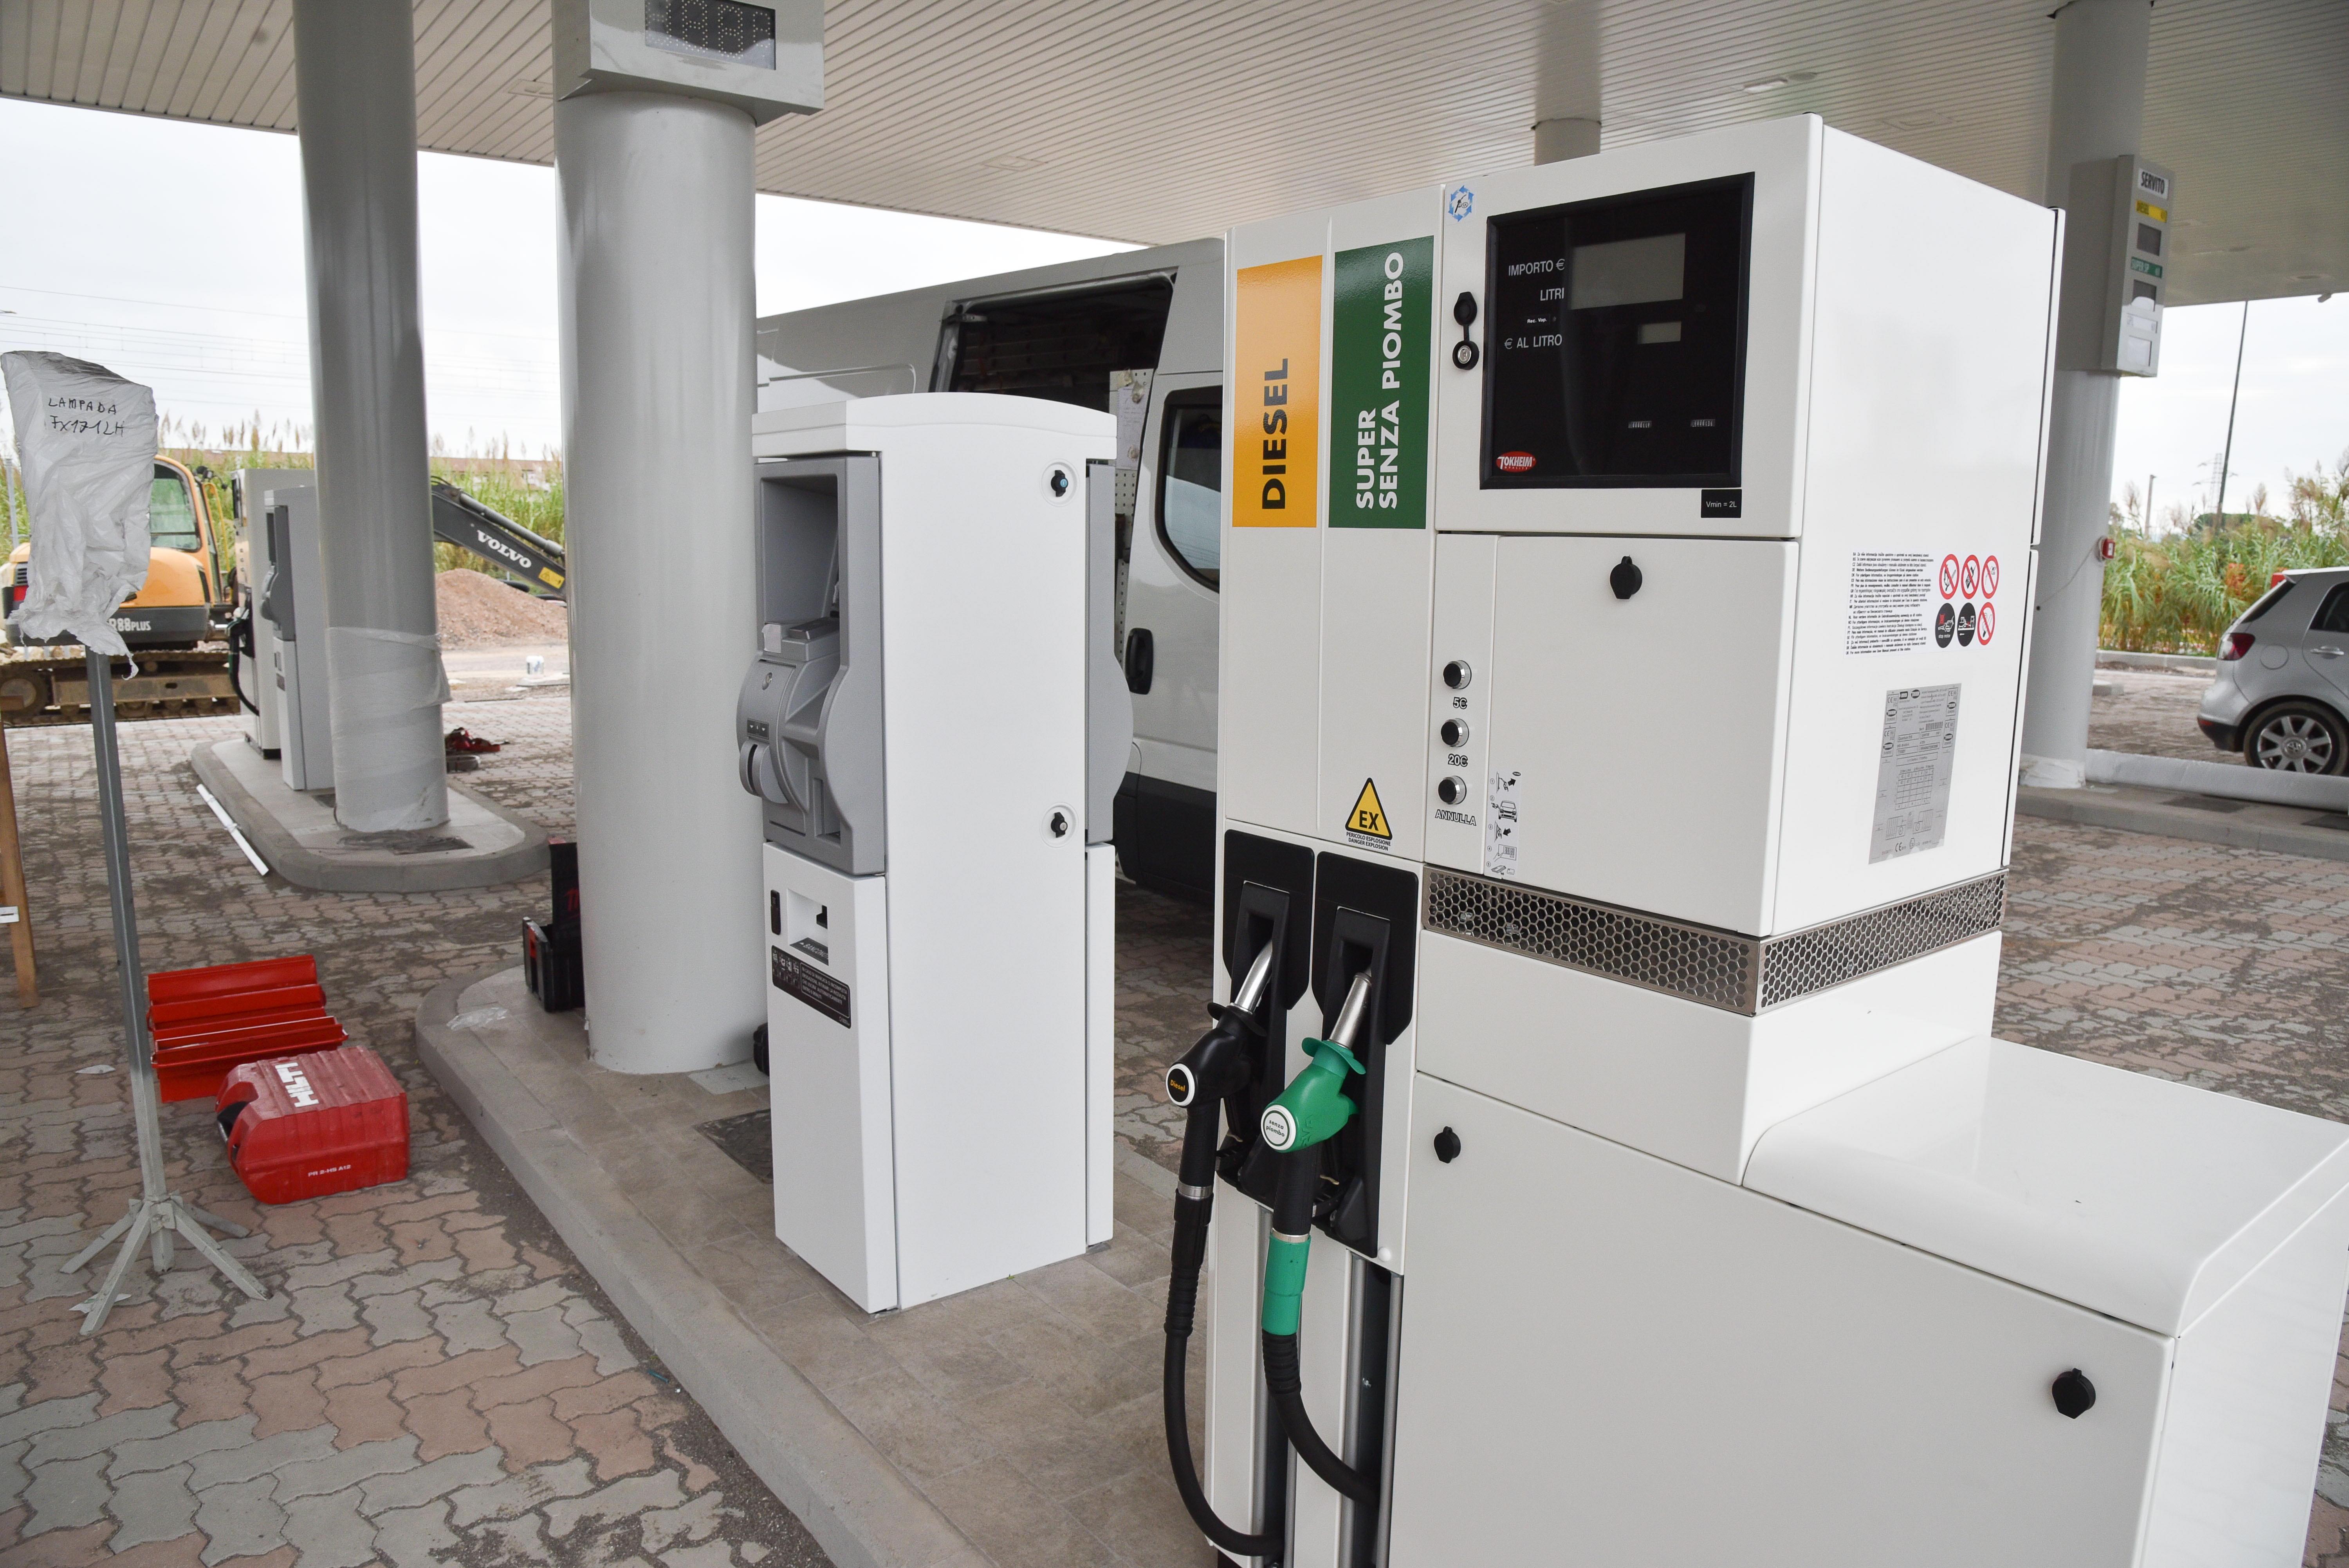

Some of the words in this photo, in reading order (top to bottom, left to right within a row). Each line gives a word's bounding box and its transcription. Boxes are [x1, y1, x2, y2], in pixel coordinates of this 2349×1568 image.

[2141, 171, 2165, 195] SERVITO
[1508, 260, 1553, 276] IMPORTO
[1555, 258, 1565, 271] €
[1540, 287, 1564, 301] LITRI
[1382, 252, 1404, 390] PIOMBO
[1504, 338, 1513, 350] €
[1517, 337, 1529, 348] AL
[1533, 334, 1562, 347] LITRO
[49, 397, 116, 415] LAMPADA
[1262, 358, 1288, 510] DIESEL
[1356, 408, 1376, 509] SUPER
[1379, 399, 1400, 509] SENZA
[1497, 456, 1533, 470] TOKHEIM
[477, 529, 532, 568] VOLVO
[1452, 697, 1468, 709] 5€
[1448, 753, 1469, 767] 20€
[1359, 810, 1379, 832] EX
[1435, 809, 1477, 826] ANNULLA
[1346, 831, 1366, 841] PERICOLO
[1366, 836, 1391, 846] ESPLOSIONE
[1348, 837, 1365, 846] DANGER
[1366, 841, 1389, 851] EXPLOSION
[274, 1062, 319, 1108] HILTI
[1170, 1079, 1186, 1092] Diesel
[1266, 1125, 1285, 1137] piombo
[1269, 1120, 1284, 1130] senza
